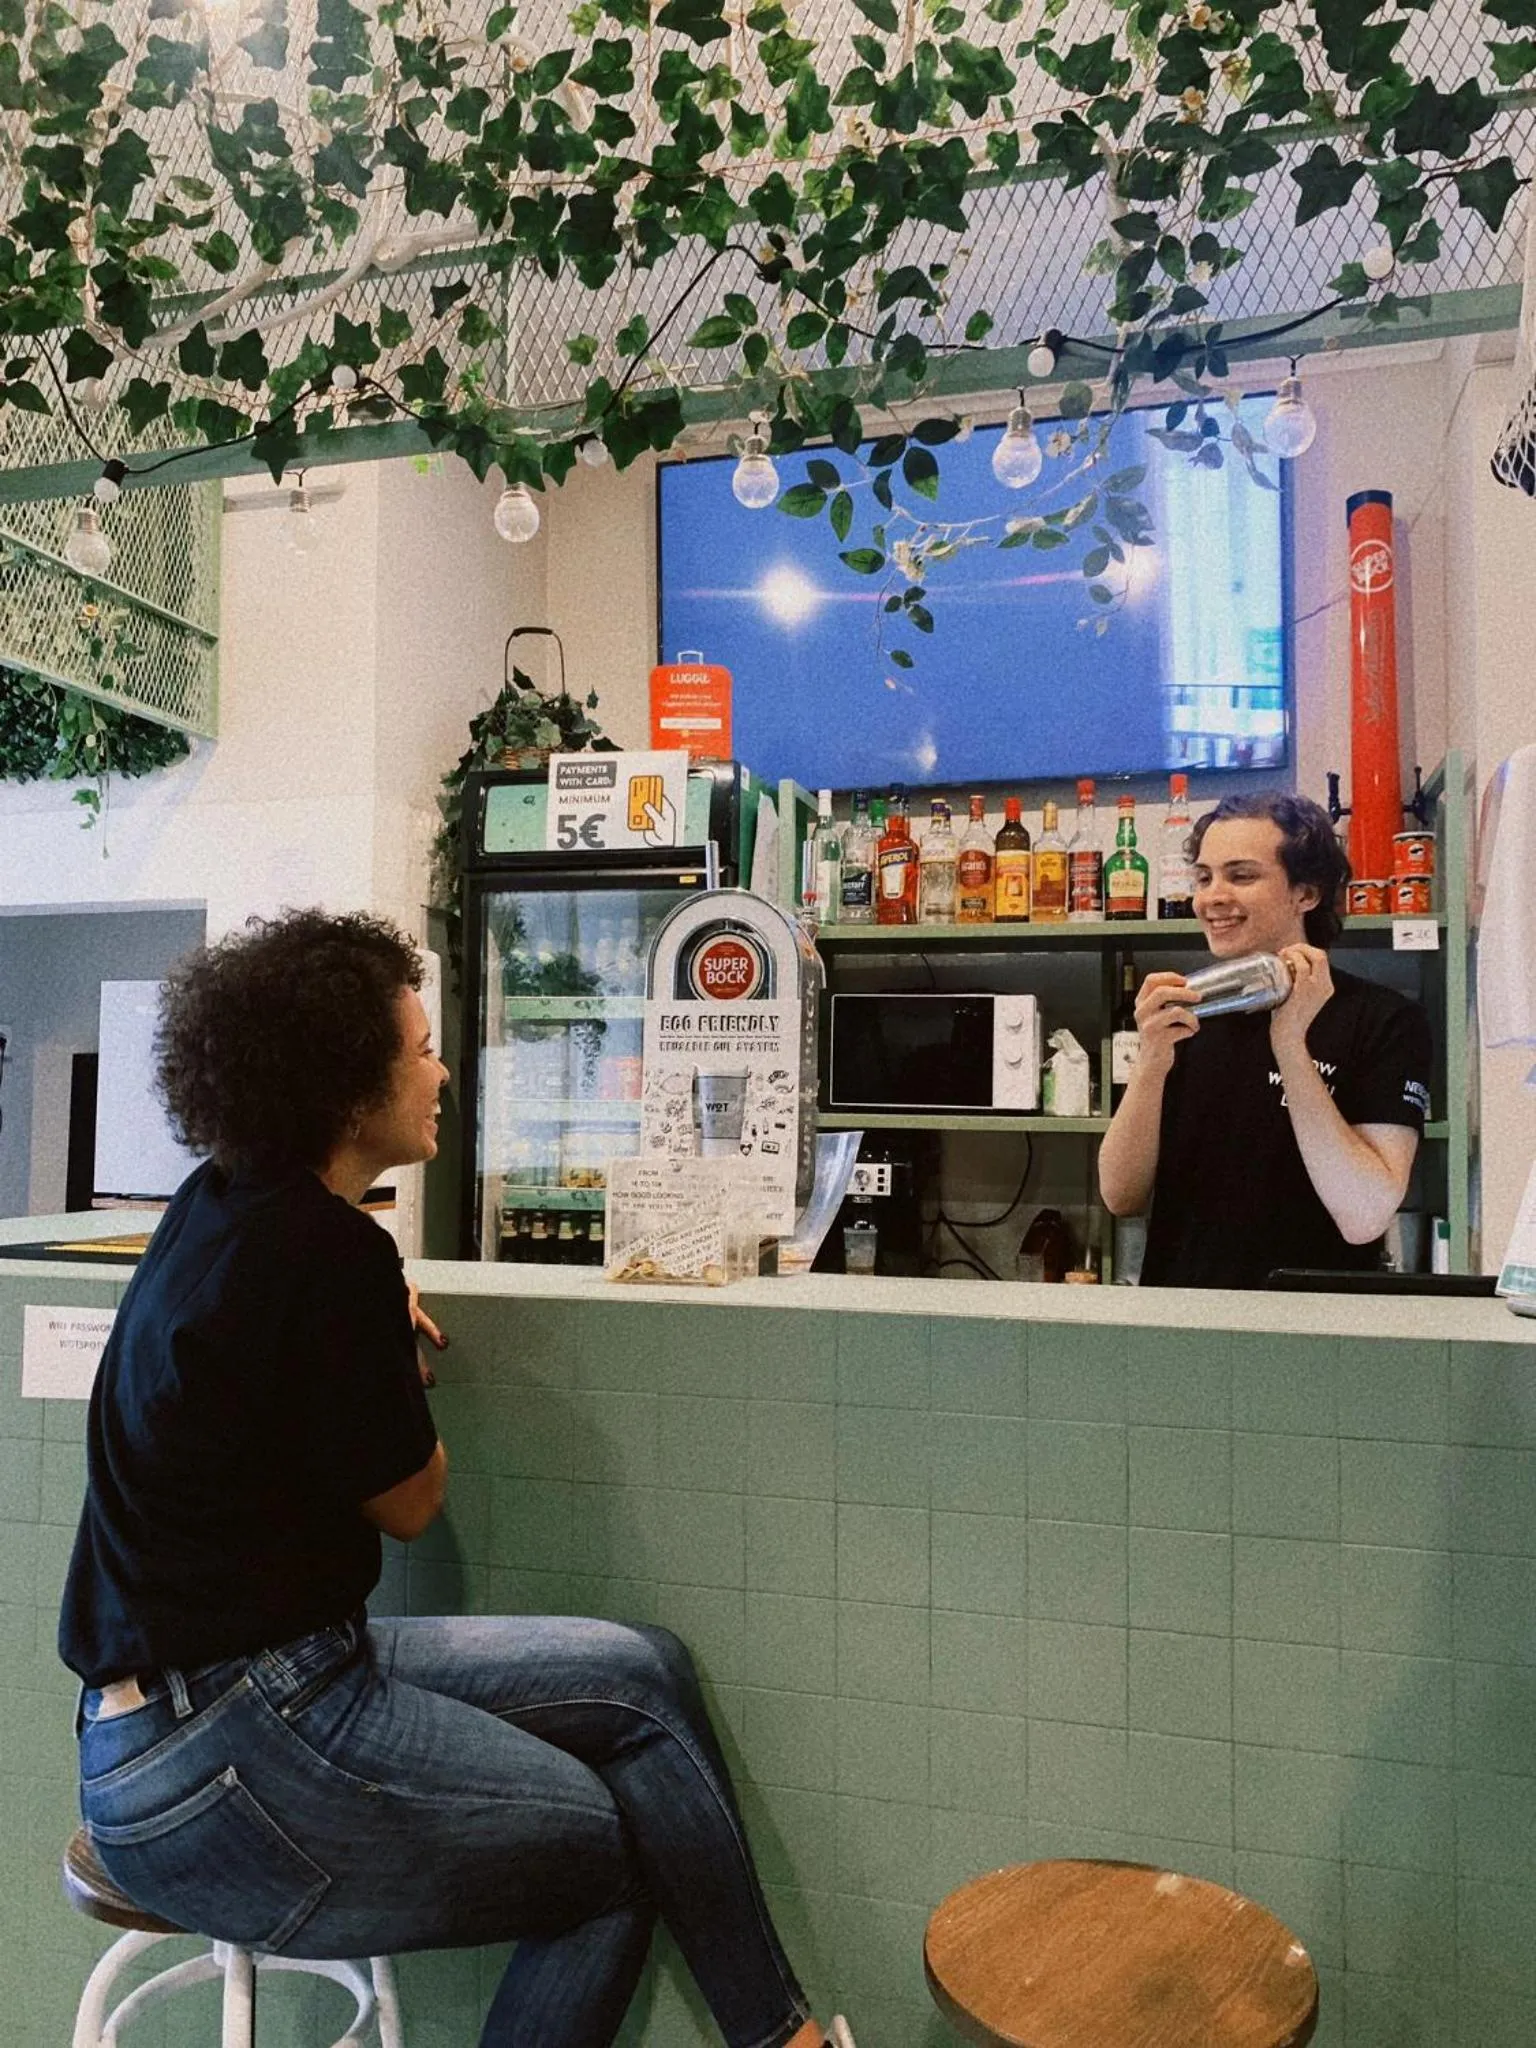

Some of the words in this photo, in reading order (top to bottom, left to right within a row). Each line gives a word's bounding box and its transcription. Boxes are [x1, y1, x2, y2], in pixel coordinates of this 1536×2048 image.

[560, 765, 608, 775] PAYMENTS
[560, 778, 582, 786] WITH
[559, 795, 610, 804] MINIMUM
[557, 813, 606, 849] 5€
[704, 957, 749, 971] SUPER
[706, 970, 747, 984] BOCK
[660, 1015, 691, 1031] ECO
[698, 1015, 780, 1032] FRIENDLY
[70, 1322, 112, 1333] PASSWOR
